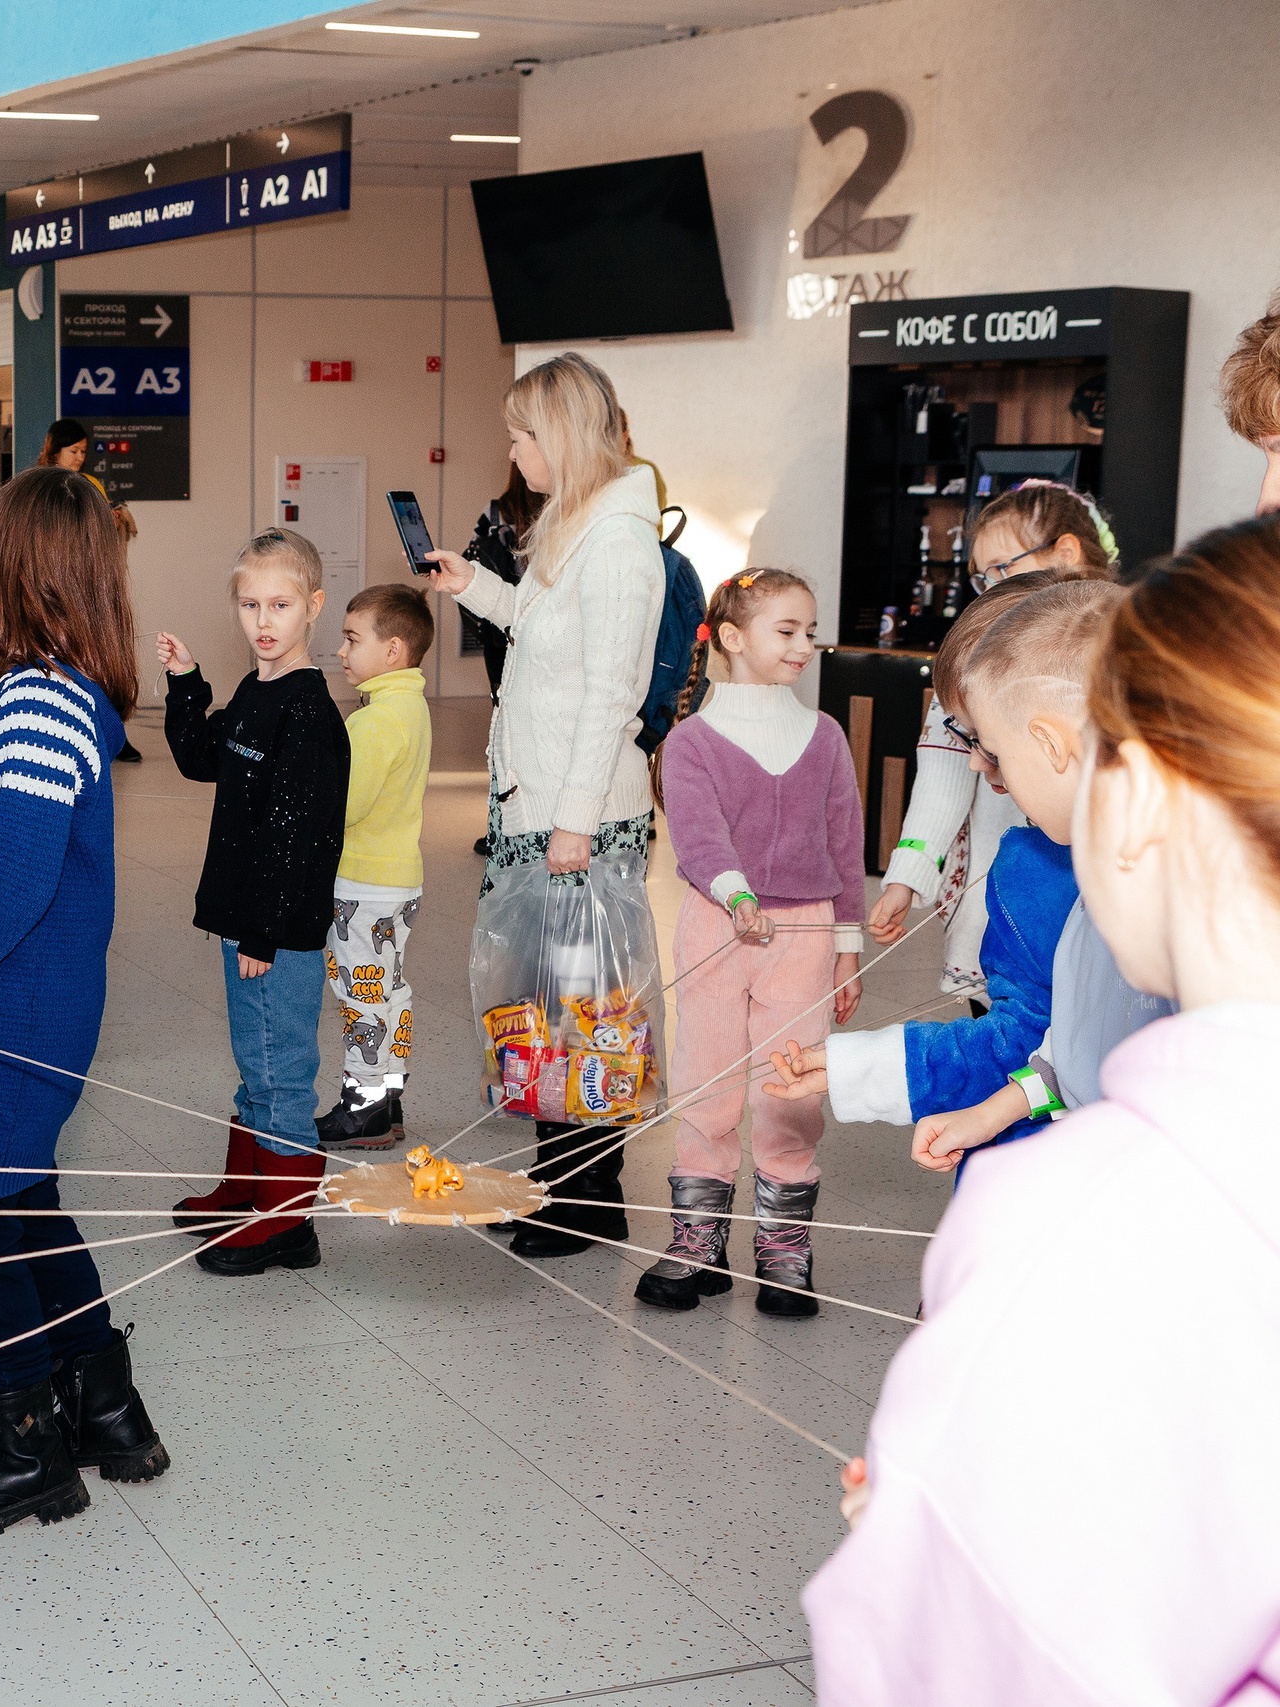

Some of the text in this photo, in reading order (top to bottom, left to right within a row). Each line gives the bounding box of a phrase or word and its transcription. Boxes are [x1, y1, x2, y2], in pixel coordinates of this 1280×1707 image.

[802, 89, 912, 260] 2
[108, 200, 195, 231] ВЫХОД НА АРЕНУ
[73, 317, 126, 325] СЕКТОРАМ
[84, 304, 126, 313] ПРОХОД
[896, 305, 1058, 347] КОФЕ С СОБОЙ
[492, 1010, 535, 1039] ХРУТК
